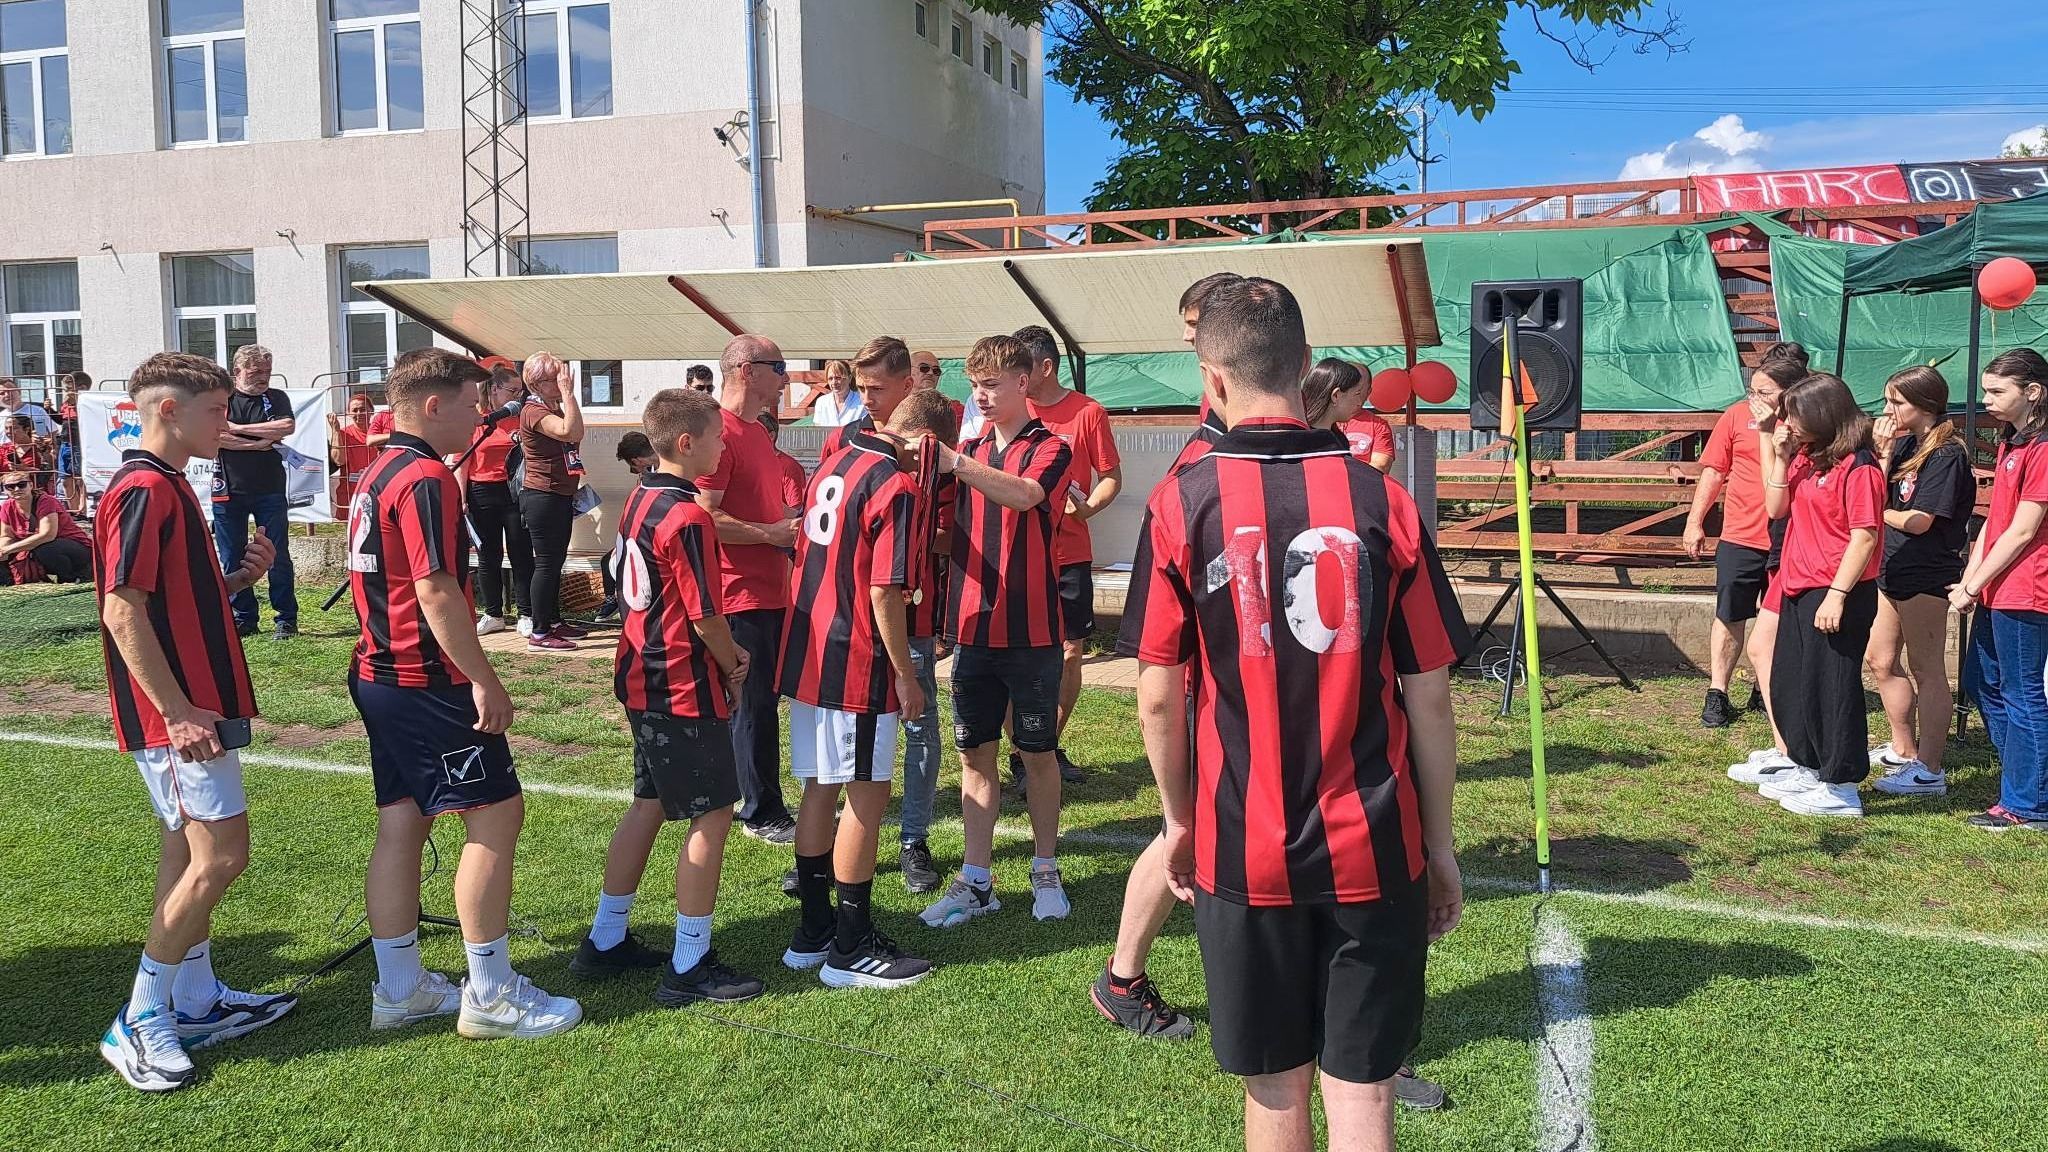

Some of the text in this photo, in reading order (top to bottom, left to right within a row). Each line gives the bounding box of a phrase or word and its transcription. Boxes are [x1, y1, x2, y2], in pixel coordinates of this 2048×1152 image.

[348, 492, 379, 573] 2
[804, 475, 845, 546] 8
[609, 531, 652, 611] 0
[1206, 526, 1374, 657] 10
